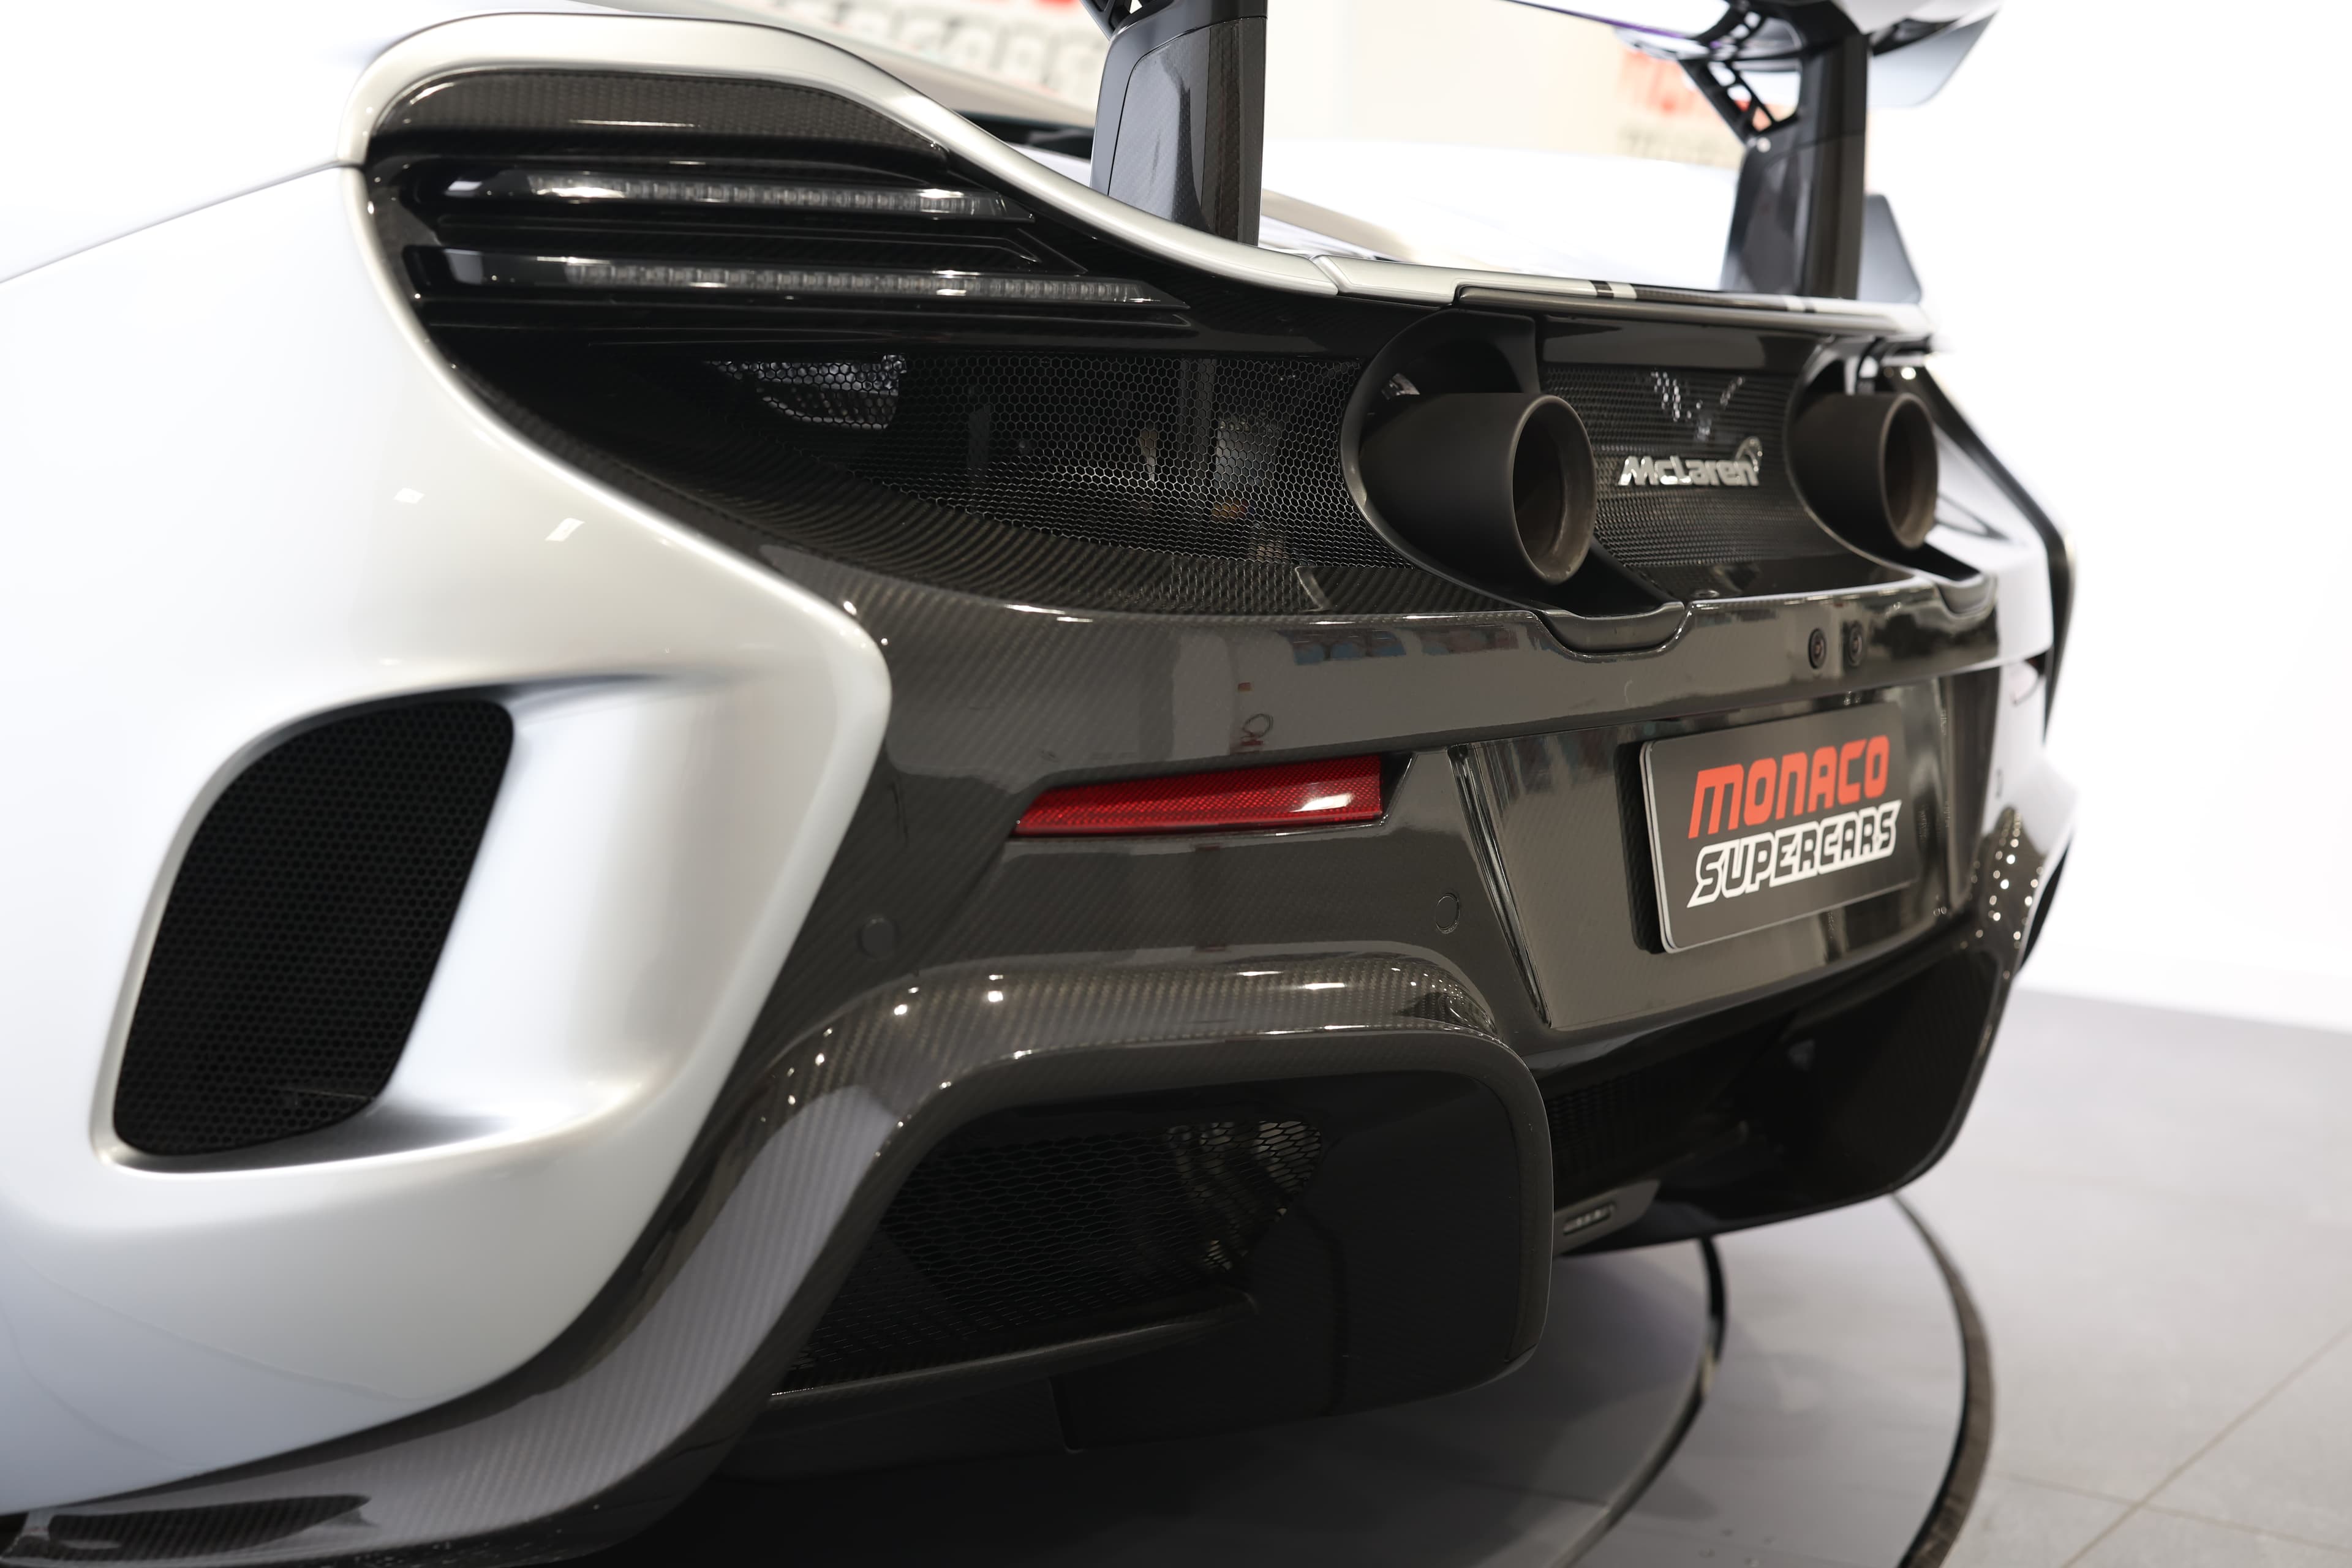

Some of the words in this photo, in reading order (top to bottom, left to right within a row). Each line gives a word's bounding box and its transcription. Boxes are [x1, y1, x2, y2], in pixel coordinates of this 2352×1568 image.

[1618, 455, 1759, 486] McLaren
[1687, 735, 1890, 839] MONACO
[1686, 799, 1902, 908] SUPERCARS
